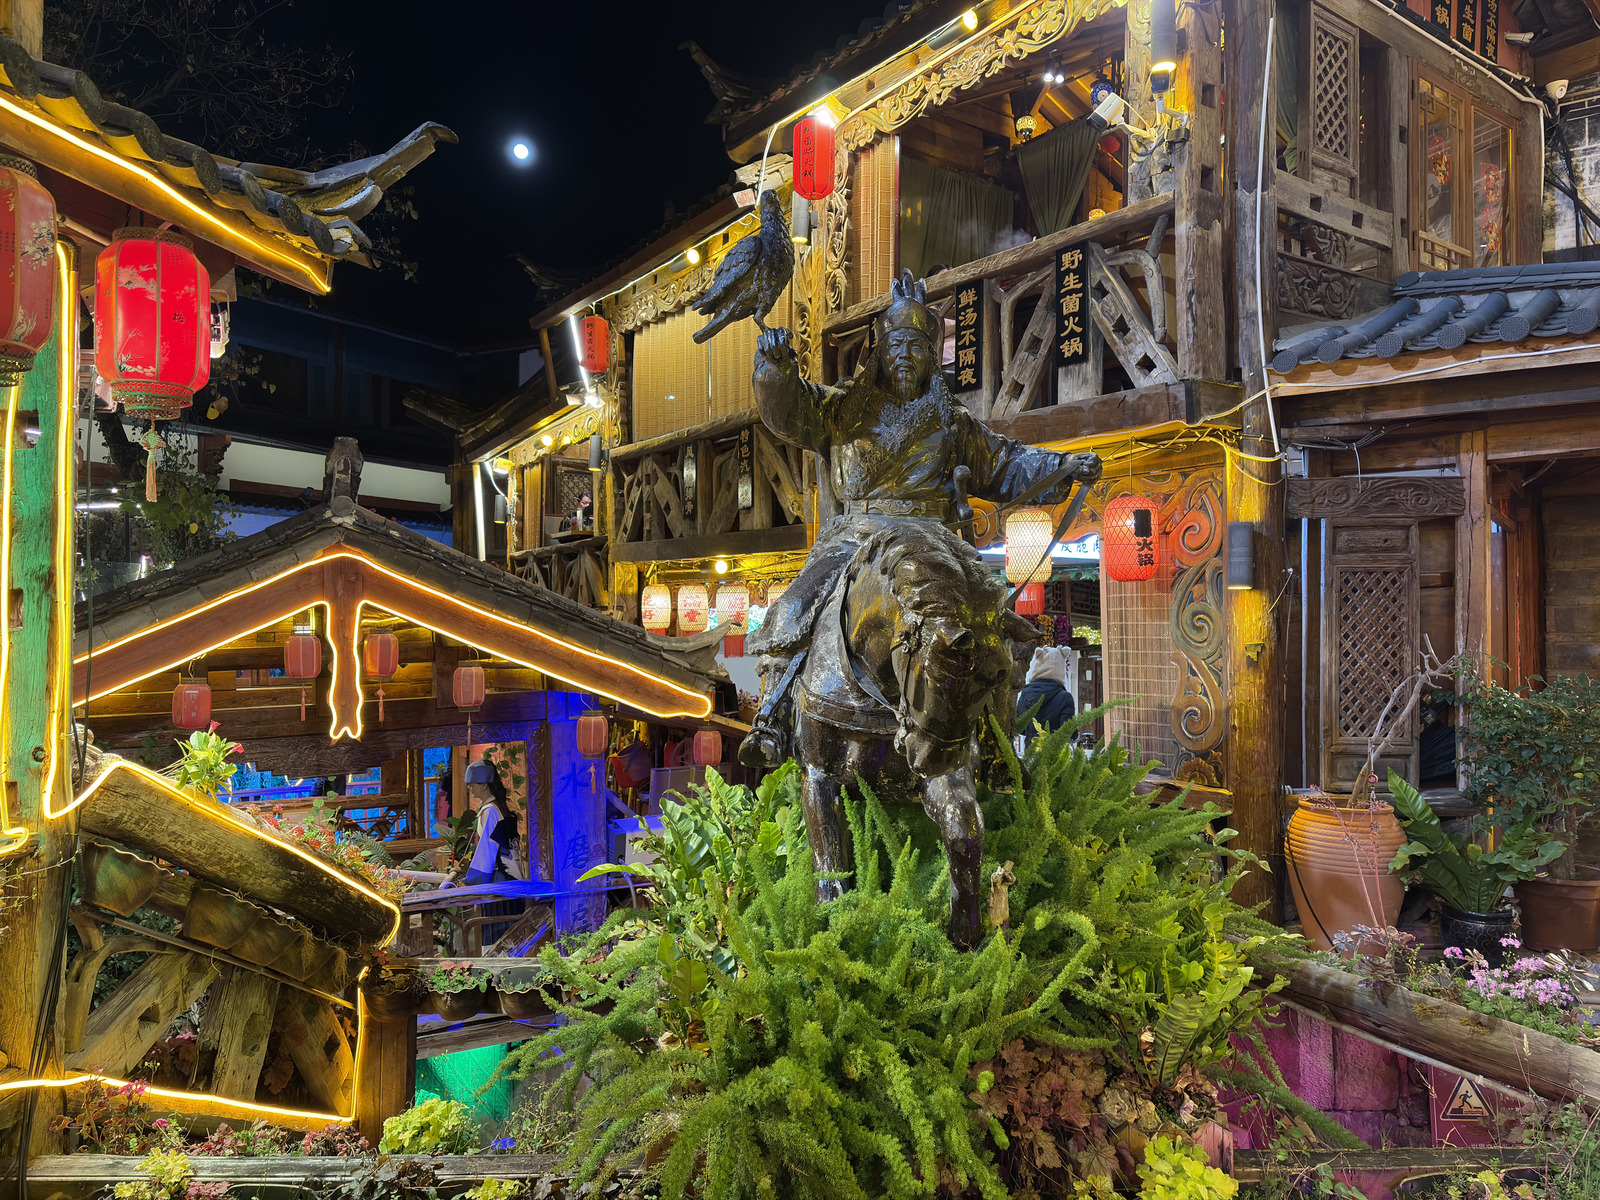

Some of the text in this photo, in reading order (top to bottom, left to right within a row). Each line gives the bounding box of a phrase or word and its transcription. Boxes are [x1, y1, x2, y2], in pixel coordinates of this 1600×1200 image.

[1435, 0, 1450, 29] 锅
[1462, 0, 1475, 43] 生菌
[1060, 249, 1083, 358] 野生菌火锅
[957, 287, 978, 387] 鲜汤不隔夜
[1136, 538, 1155, 567] 火锅
